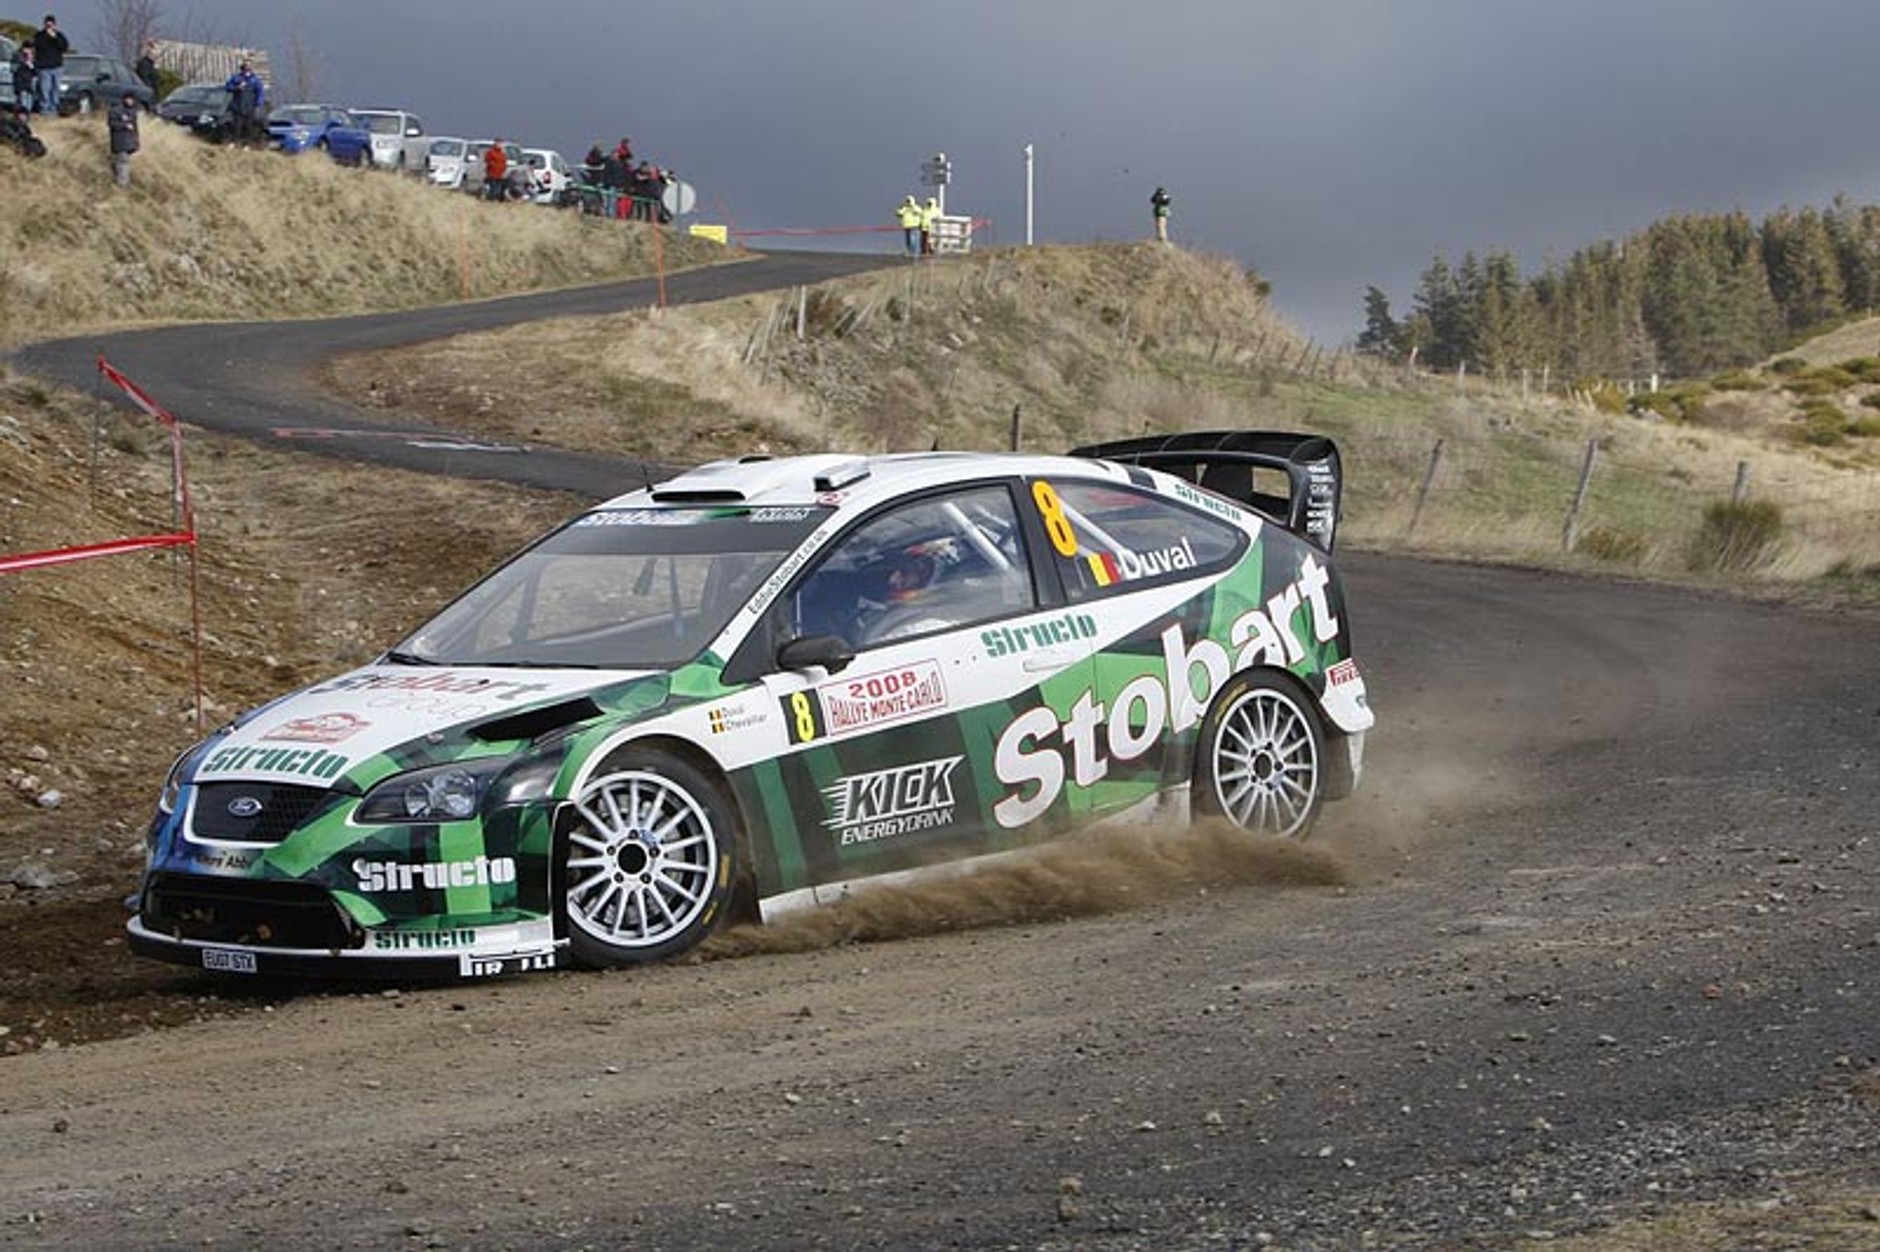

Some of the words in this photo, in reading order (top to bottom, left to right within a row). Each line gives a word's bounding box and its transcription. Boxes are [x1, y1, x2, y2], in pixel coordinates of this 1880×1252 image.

[1032, 479, 1079, 558] 8
[1114, 536, 1197, 581] Duval
[980, 613, 1099, 658] Structo
[848, 670, 918, 699] 2008
[869, 691, 908, 720] MONTE
[909, 670, 946, 712] CARLO
[992, 553, 1339, 829] Stobart
[791, 690, 816, 743] 8
[201, 745, 351, 780] Structo
[838, 755, 965, 830] KICK
[356, 855, 517, 892] Structo
[374, 929, 477, 949] Structo
